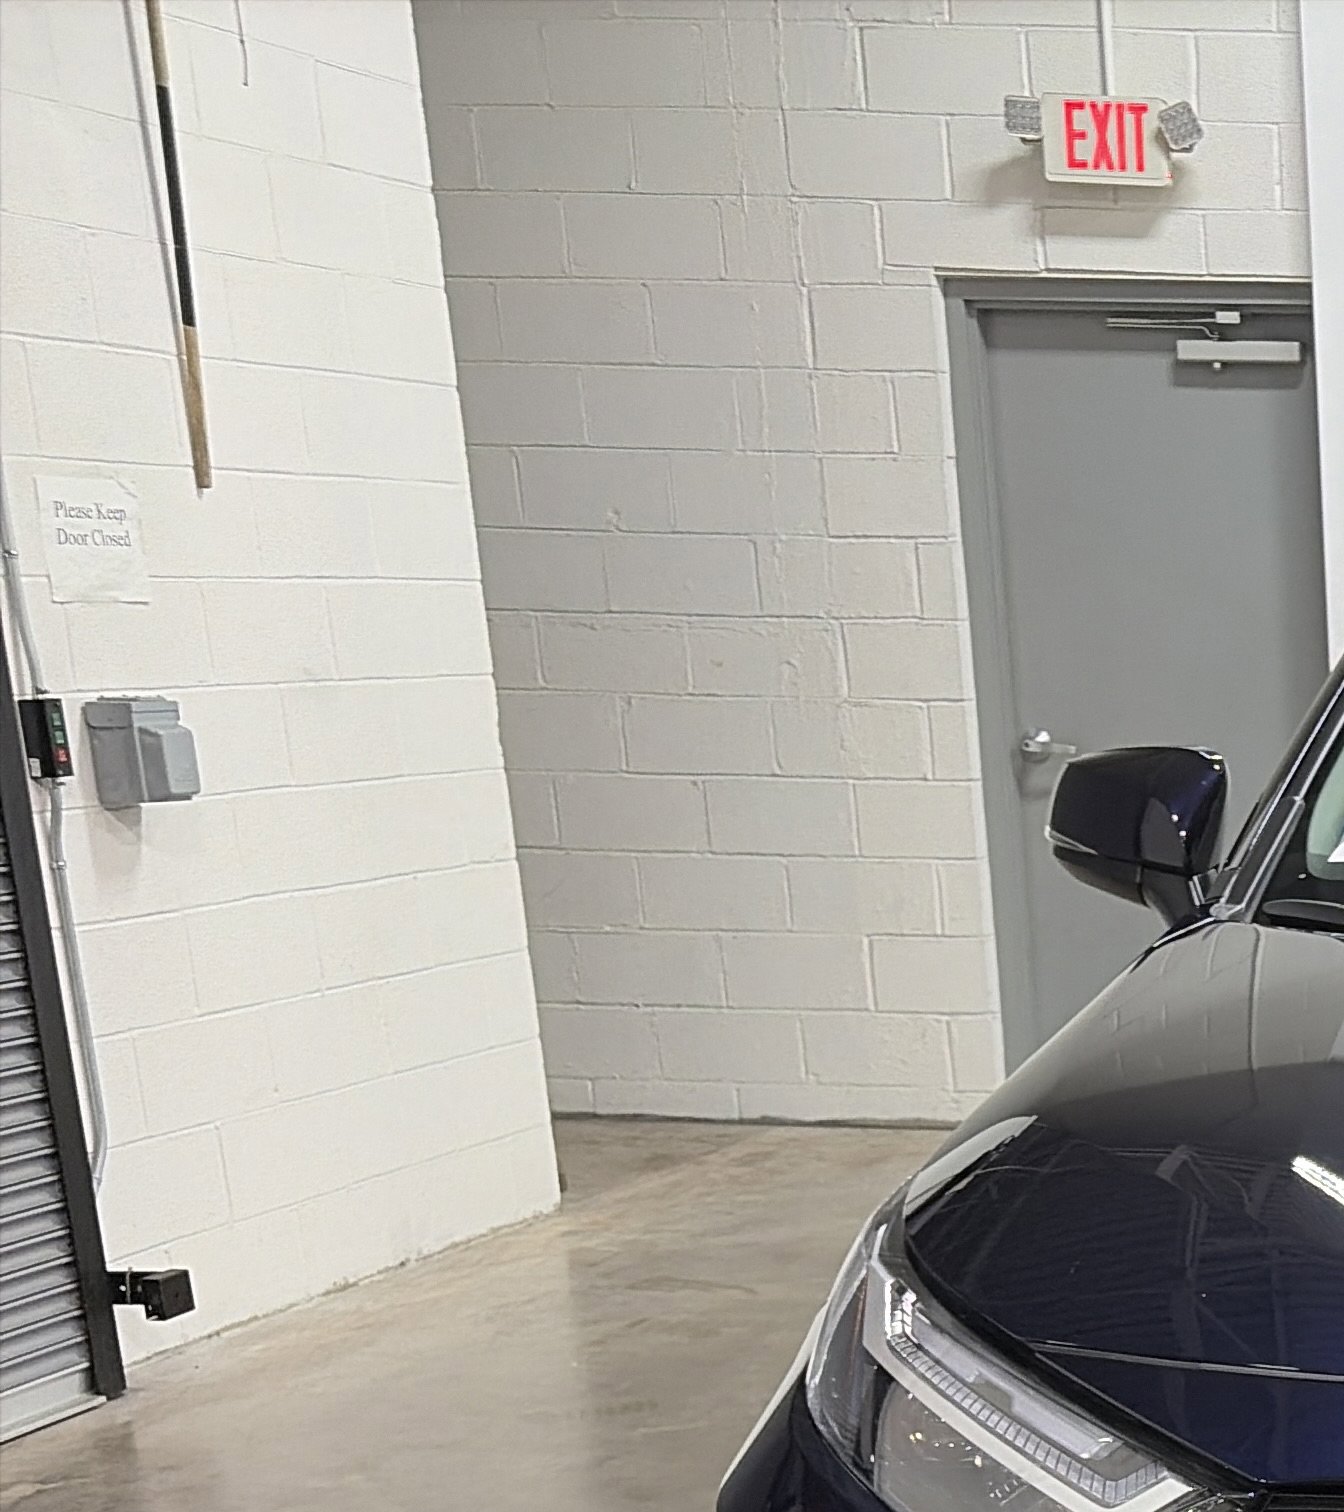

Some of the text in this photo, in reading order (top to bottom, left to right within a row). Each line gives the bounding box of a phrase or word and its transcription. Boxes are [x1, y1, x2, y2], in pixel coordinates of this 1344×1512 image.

[1064, 100, 1149, 172] EXIT
[53, 500, 126, 525] Please Keep
[56, 527, 132, 547] Door Closed
